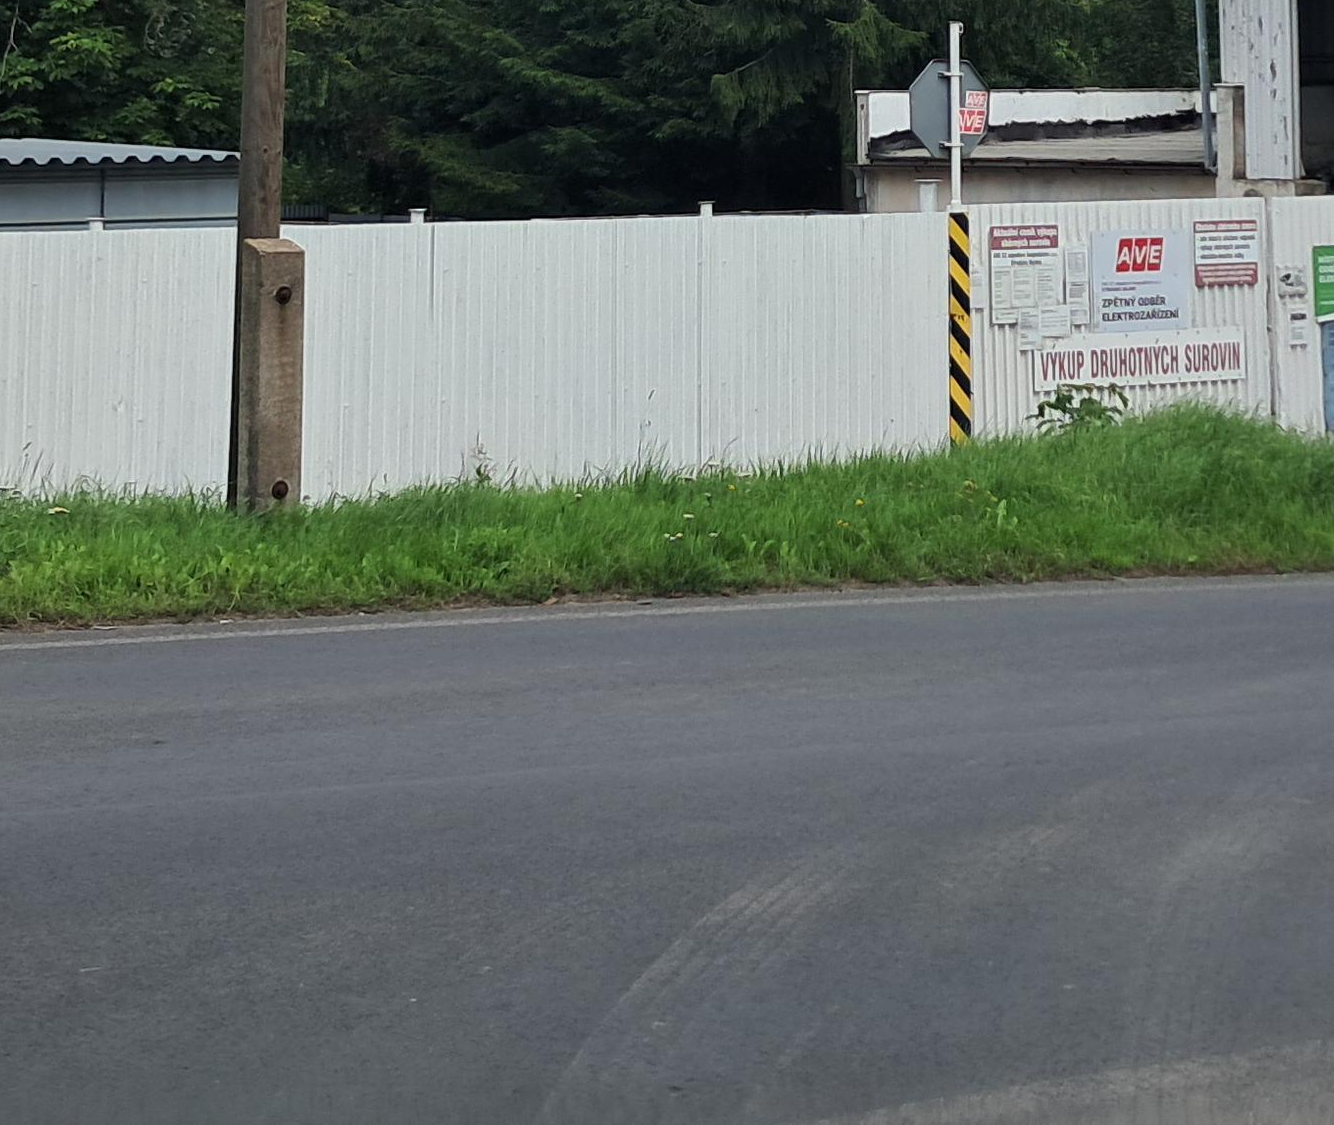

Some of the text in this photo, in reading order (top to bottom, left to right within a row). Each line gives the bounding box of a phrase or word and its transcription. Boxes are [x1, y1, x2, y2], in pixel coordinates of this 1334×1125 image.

[1116, 243, 1163, 267] AVE
[1102, 295, 1136, 308] ZPĚTNÝ
[1102, 308, 1179, 322] ELEKTROZAŘÍZENÍ
[1040, 338, 1241, 381] VÝKUP DRUHOTNÝCH SUROVIN
